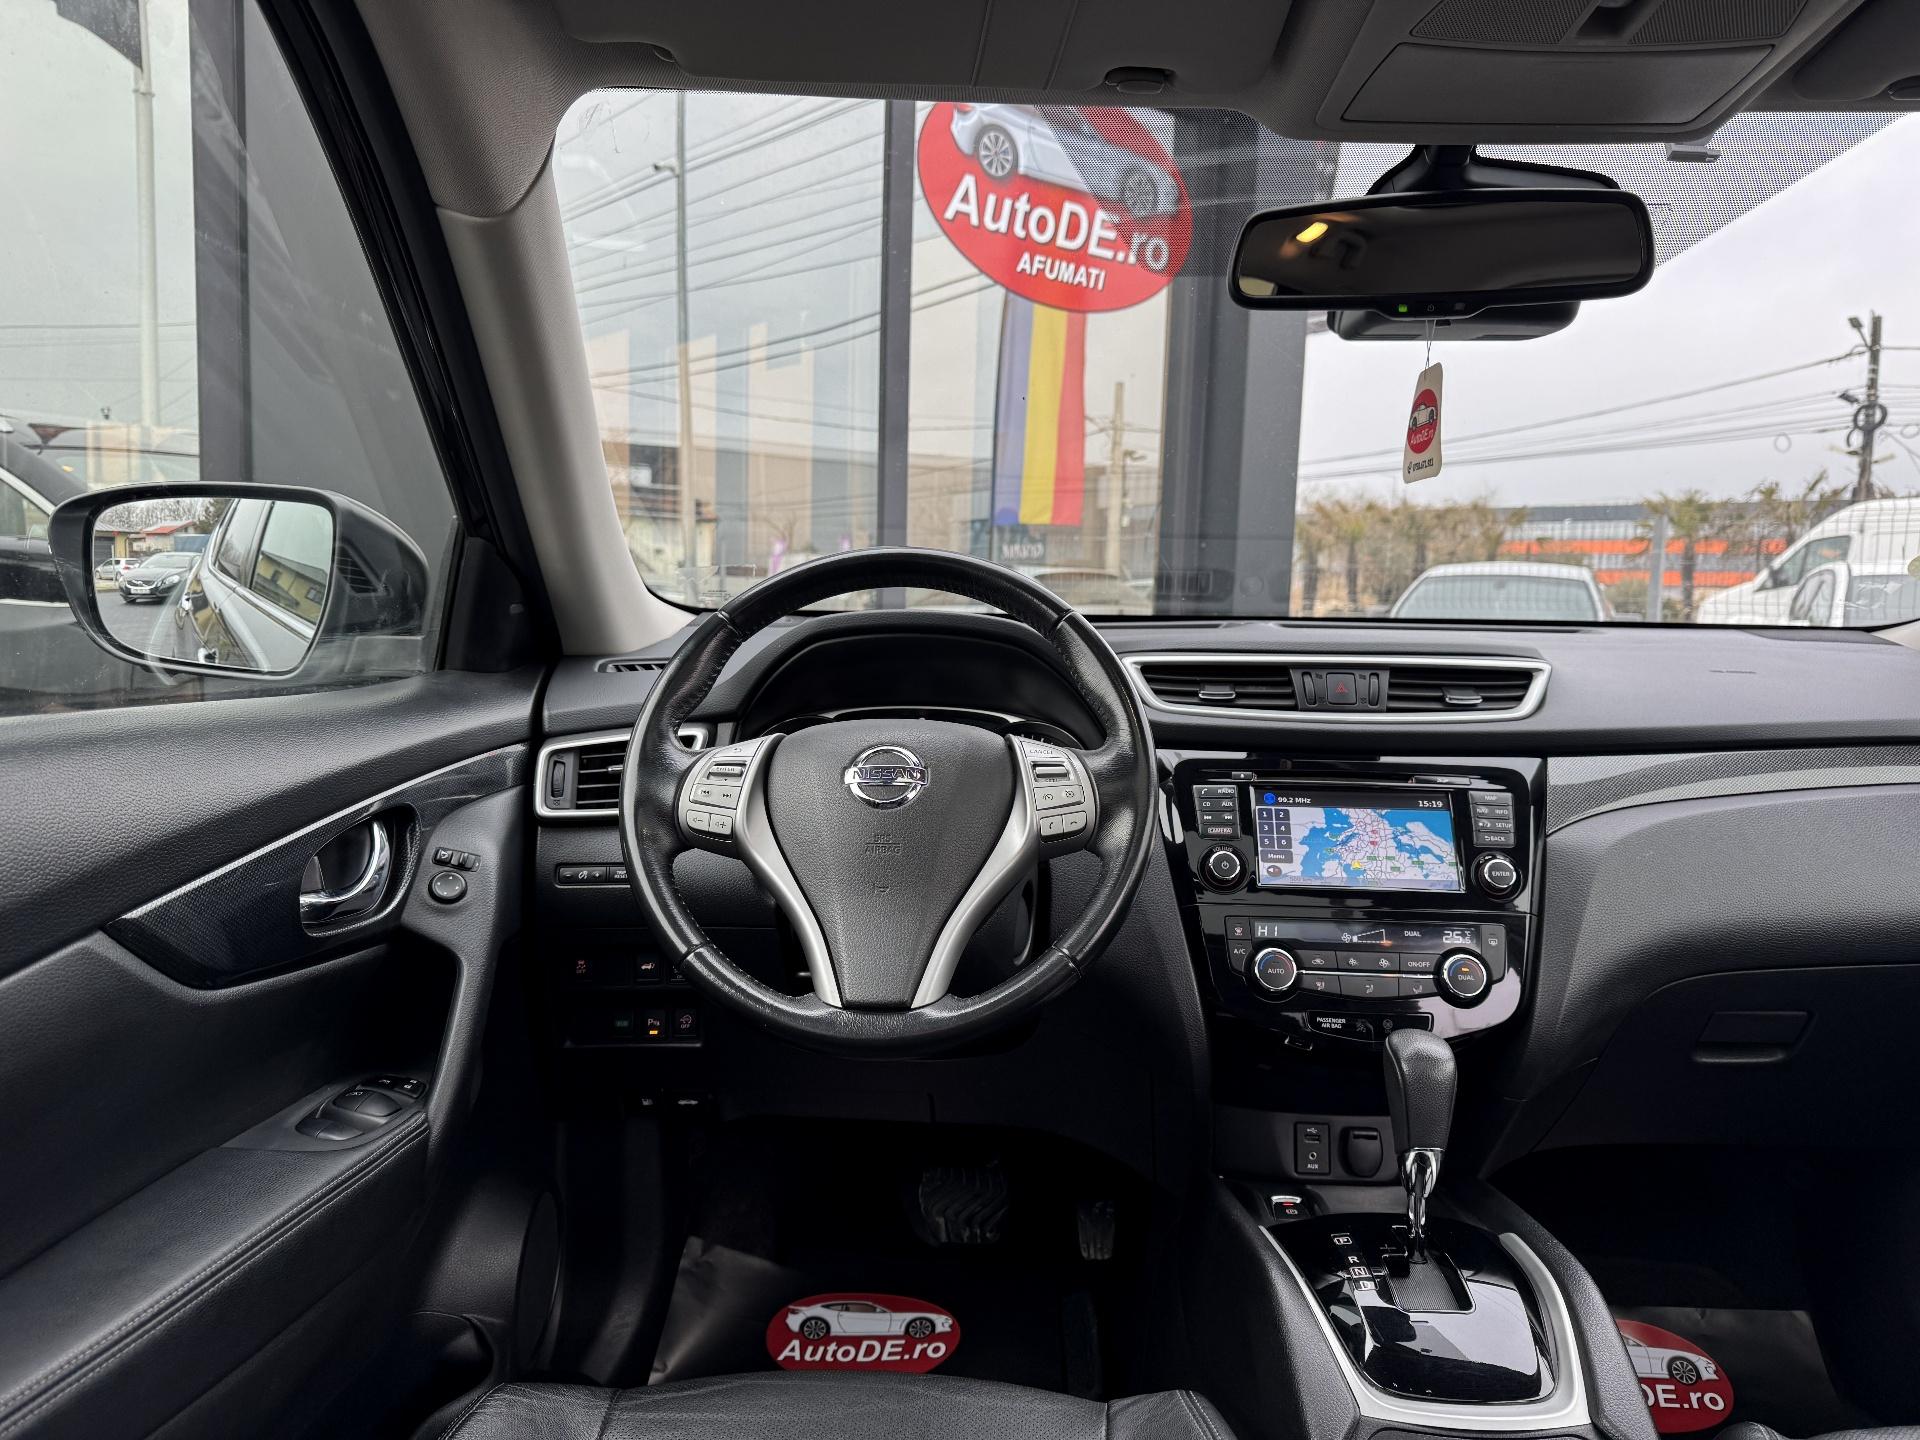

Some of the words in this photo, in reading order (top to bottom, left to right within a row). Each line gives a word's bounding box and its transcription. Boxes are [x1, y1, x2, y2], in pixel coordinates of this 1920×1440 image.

[943, 172, 1171, 272] AutoDE.ro
[1016, 251, 1106, 291] AFUMATI
[852, 767, 919, 781] NISSAN
[1418, 800, 1443, 808] 15:19
[864, 845, 902, 855] AIRBAG
[1404, 930, 1422, 938] DUAL
[1267, 967, 1285, 975] AUTO
[1316, 1016, 1346, 1025] PASSENGER
[1348, 1255, 1360, 1264] R
[776, 1339, 947, 1363] AutoDE.ro
